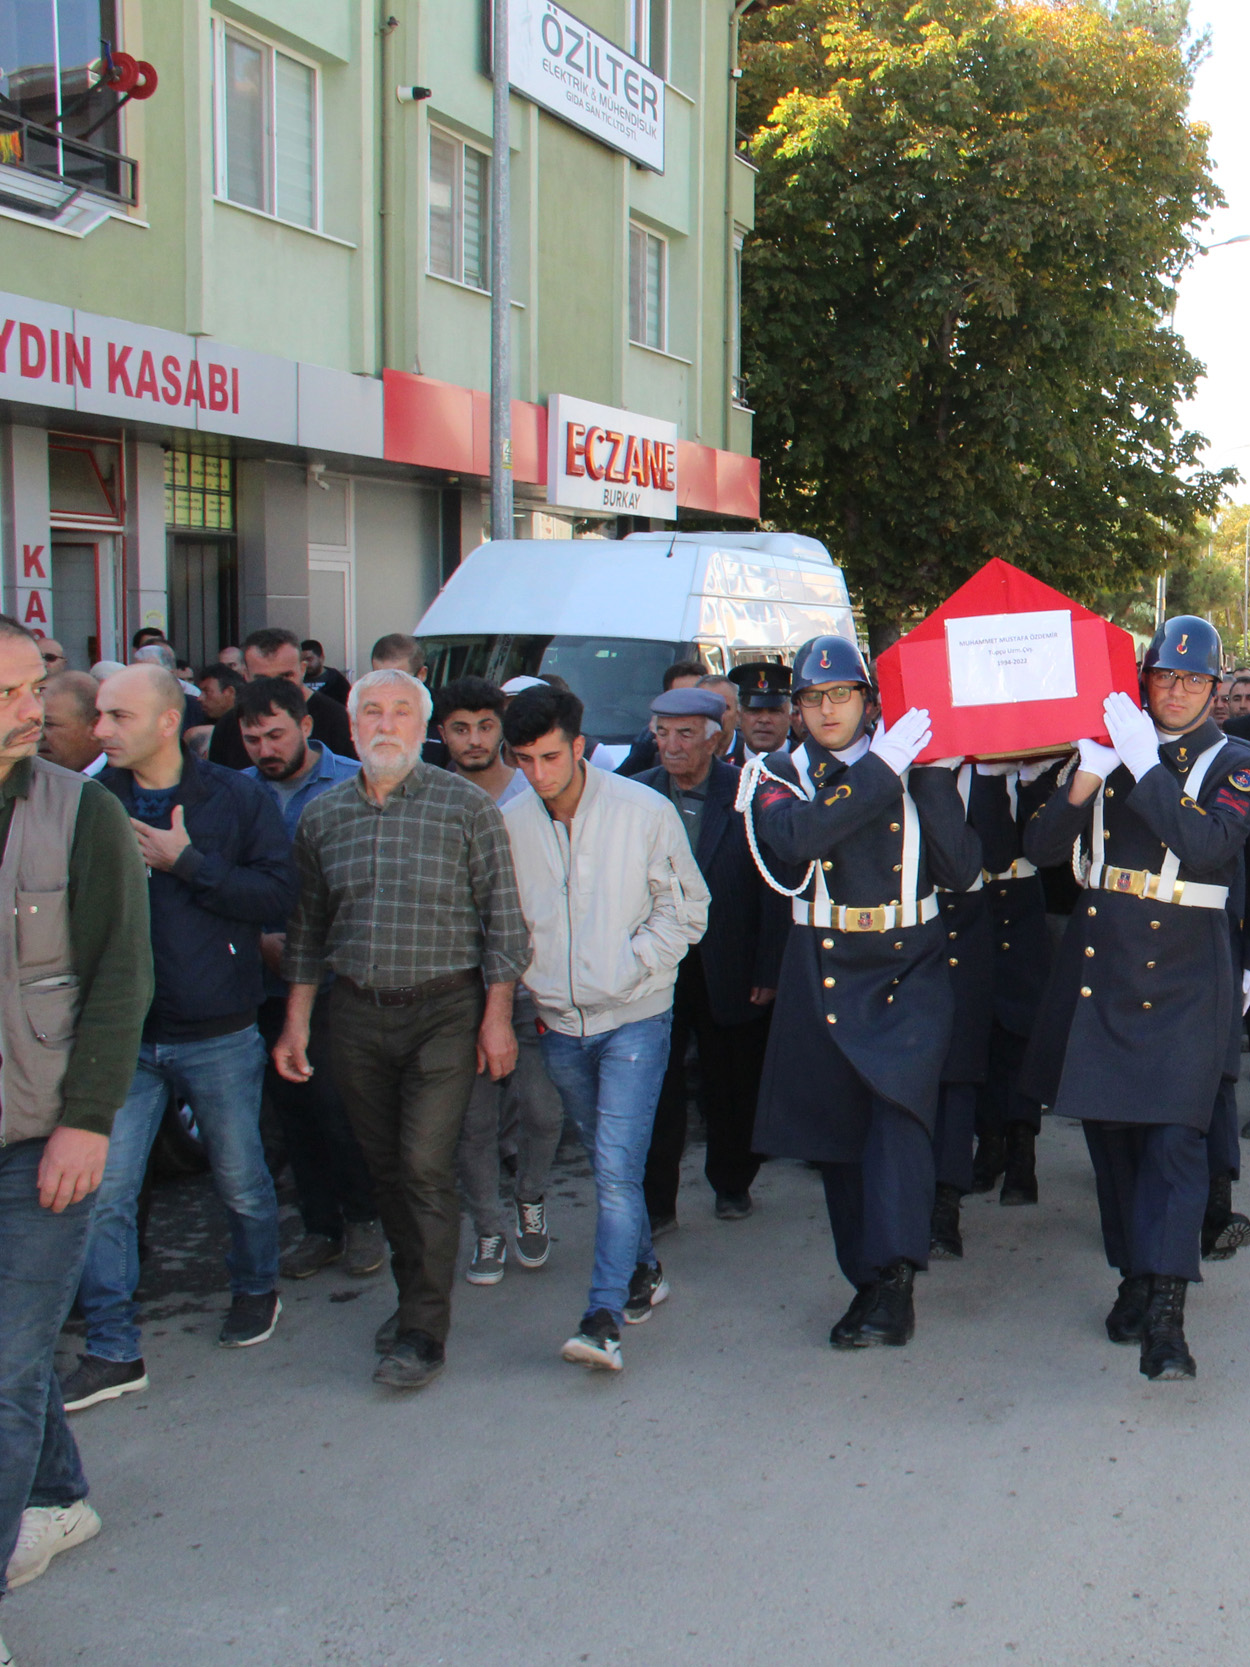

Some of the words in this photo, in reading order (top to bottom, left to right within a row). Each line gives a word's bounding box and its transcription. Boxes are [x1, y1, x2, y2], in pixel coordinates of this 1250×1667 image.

[541, 4, 658, 122] ÖZİLTER
[542, 58, 589, 97] ELEKTRİK
[591, 87, 597, 101] &
[599, 93, 657, 140] MÜHENDİSLİK
[566, 90, 584, 109] GIDA
[107, 341, 239, 415] KASABI
[565, 420, 676, 492] ECZANE
[603, 488, 641, 509] BURKAY
[959, 638, 998, 647] MUHAMMET
[999, 635, 1029, 643] MUSTAFA
[1029, 631, 1058, 640] ÖZDEMİR
